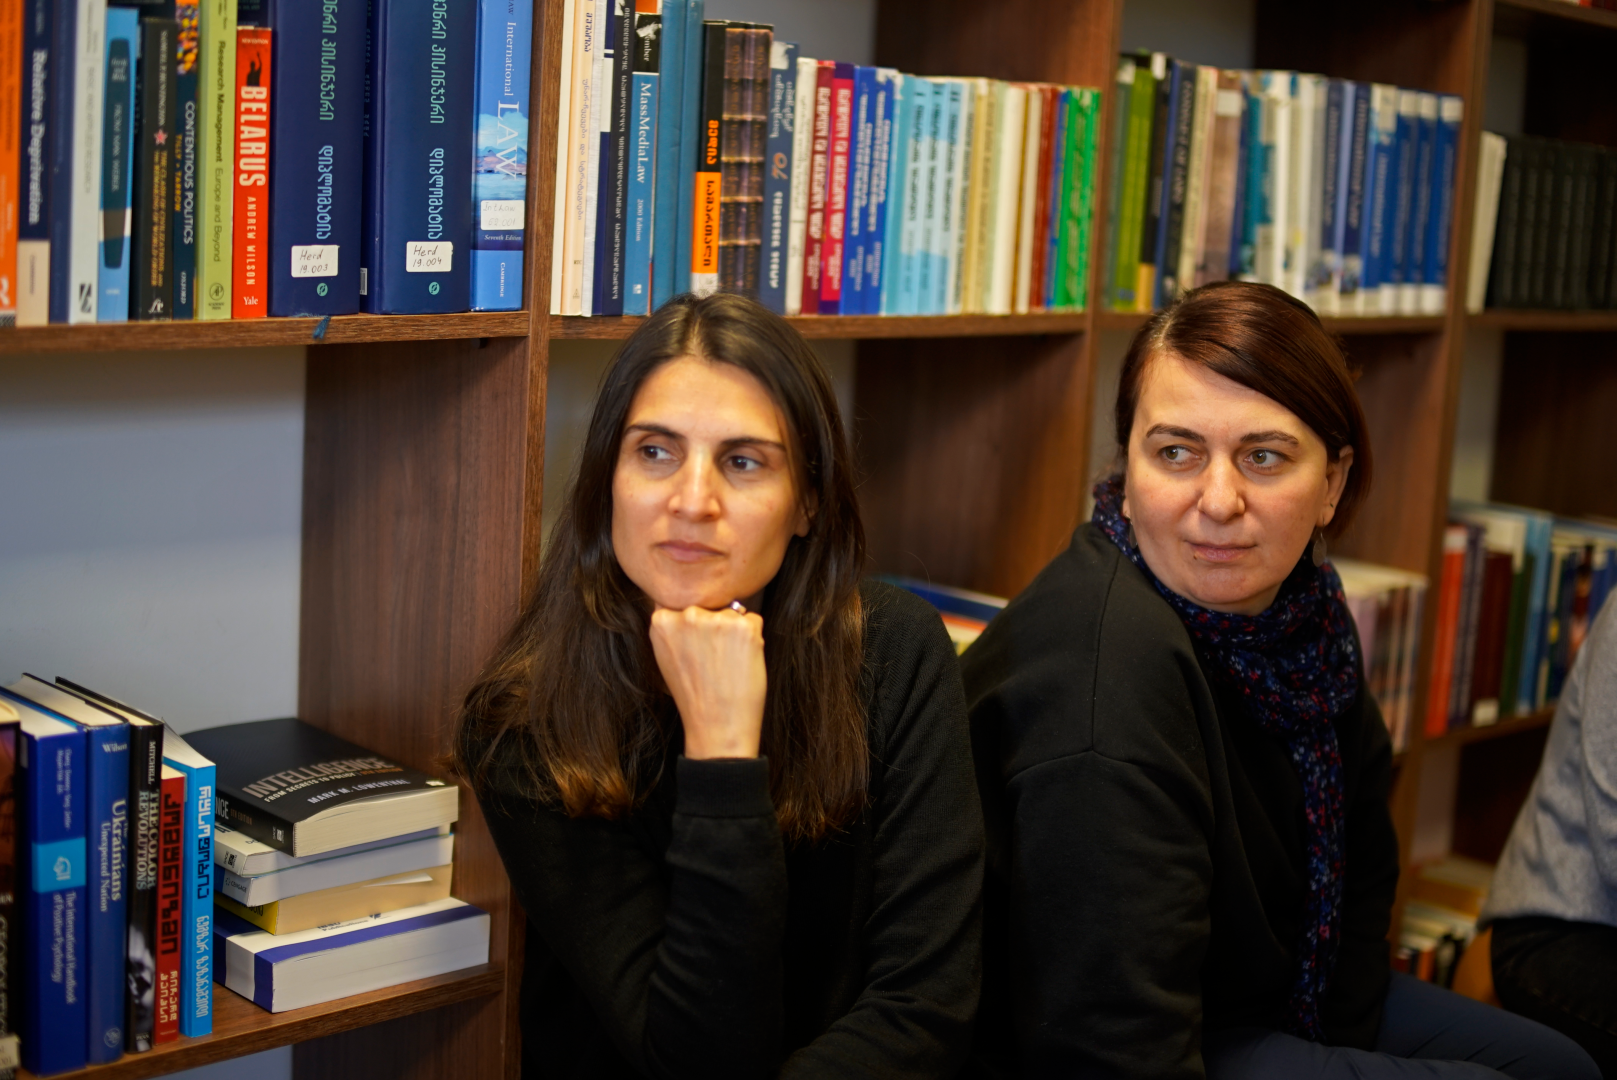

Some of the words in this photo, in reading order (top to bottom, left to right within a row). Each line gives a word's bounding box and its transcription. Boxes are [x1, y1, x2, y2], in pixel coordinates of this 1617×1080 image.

[431, 0, 447, 39] ენრი
[217, 40, 227, 91] Research
[319, 38, 336, 121] კისინჯერი
[503, 21, 517, 97] International
[32, 49, 48, 122] Relative
[429, 44, 446, 124] კისინჯერი
[175, 134, 183, 159] TILLY
[184, 101, 196, 189] CONTENTIOUS
[215, 93, 225, 163] Management
[239, 86, 267, 187] BELARUS
[496, 100, 520, 180] LAW
[579, 143, 587, 156] და
[635, 82, 652, 184] MassMediaLaw
[706, 119, 719, 165] მედია
[28, 122, 46, 226] Deprivation
[160, 151, 168, 167] THE
[771, 152, 788, 180] 70
[152, 164, 160, 210] REMAKING
[159, 199, 166, 210] OF
[174, 171, 182, 212] TARROW
[213, 167, 224, 202] Europe
[316, 145, 334, 240] დიპლომატია
[428, 148, 444, 240] დიპლომატია
[183, 191, 195, 245] POLITICS
[215, 204, 223, 223] and
[246, 196, 257, 240] ANDREW
[637, 199, 645, 216] 2000
[702, 179, 716, 267] სამართალი
[158, 211, 166, 272] CIVILIZATIONS
[212, 225, 222, 263] Beyond
[413, 244, 438, 256] Herd
[635, 217, 643, 242] Edition
[151, 256, 159, 287] ORDER
[246, 245, 256, 285] WILSON
[299, 248, 324, 261] Herd
[299, 263, 329, 274] 19.003
[412, 256, 442, 268] 19.004
[243, 295, 259, 306] Yale
[148, 740, 156, 785] MITCHELL
[242, 757, 396, 800] INTELLIGENCE
[148, 789, 160, 828] THE
[264, 789, 289, 803] FROM
[286, 778, 319, 796] SECRETS
[307, 789, 340, 804] MARK
[337, 787, 355, 795] M.
[352, 778, 412, 792] LOWENTHAL
[98, 821, 111, 877] Unexpected
[111, 799, 127, 902] Ukrainians
[136, 791, 150, 891] REVOLUTIONS
[147, 829, 159, 890] COLOR
[197, 785, 212, 900] რუსოფობია
[100, 879, 110, 912] Nation
[160, 793, 182, 956] კომუნიზმი
[52, 905, 64, 936] Positive
[53, 894, 64, 904] of
[66, 891, 78, 908] The
[65, 909, 77, 961] International
[51, 938, 63, 983] Psychology
[64, 962, 77, 1004] Handbook
